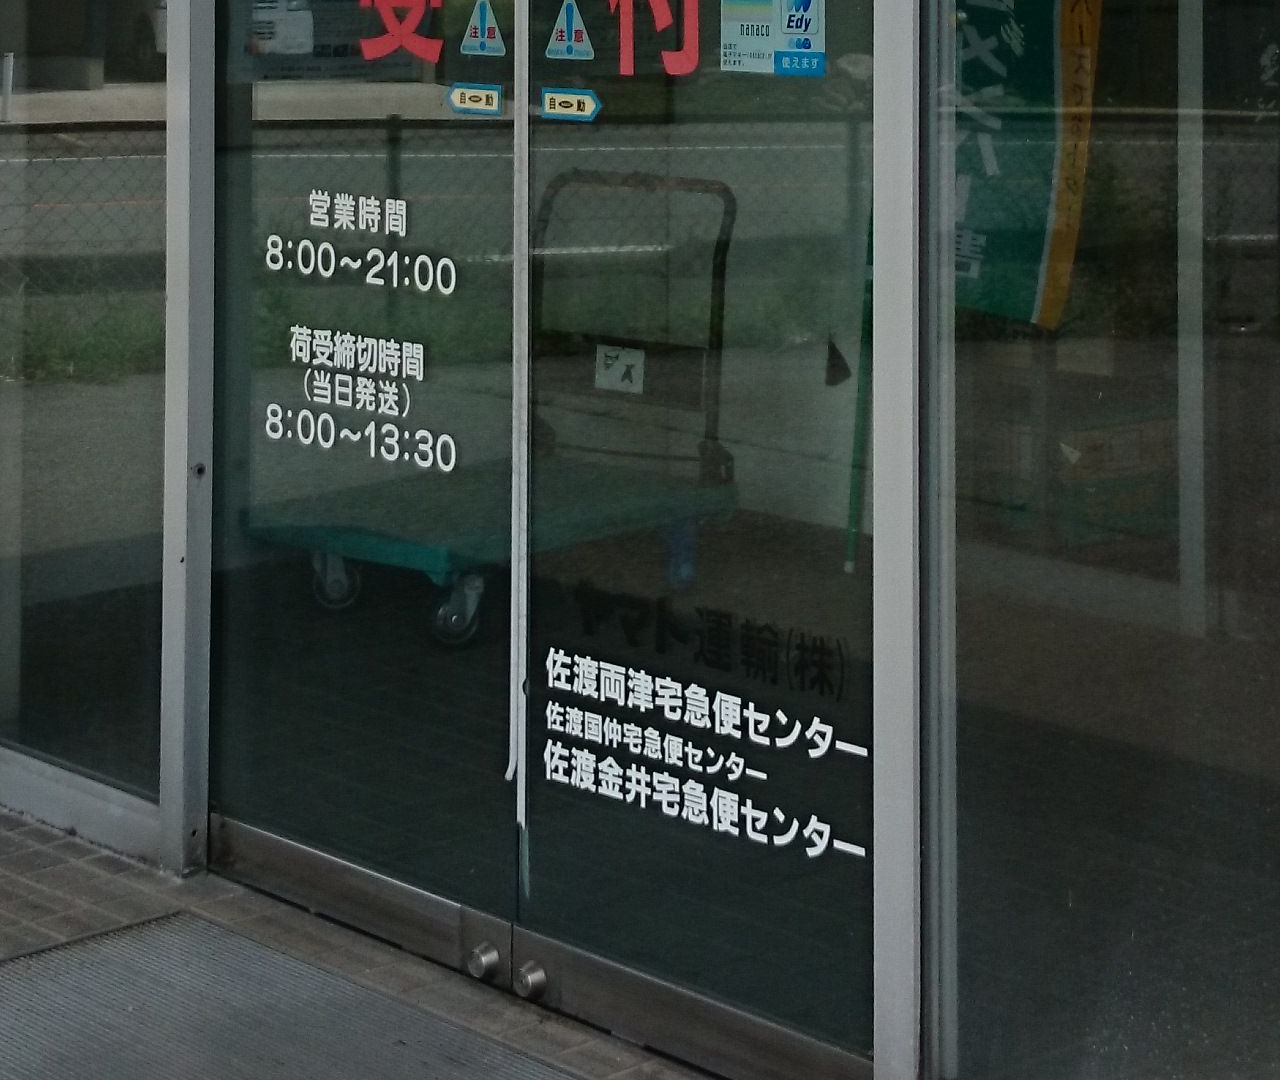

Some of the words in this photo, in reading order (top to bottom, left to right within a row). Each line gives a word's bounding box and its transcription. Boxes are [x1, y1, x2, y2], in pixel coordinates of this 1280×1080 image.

[740, 23, 770, 37] nanaco
[786, 14, 812, 32] Edy
[781, 57, 819, 69] 使えます
[308, 189, 408, 237] 営業時間
[289, 325, 425, 382] 荷受締切時間
[303, 369, 412, 417] （当日発送）
[545, 648, 868, 758] 佐渡両津宅急便センター
[545, 701, 767, 781] 佐渡国仲宅急便センター
[543, 740, 866, 858] 佐渡金井宅急便センター
